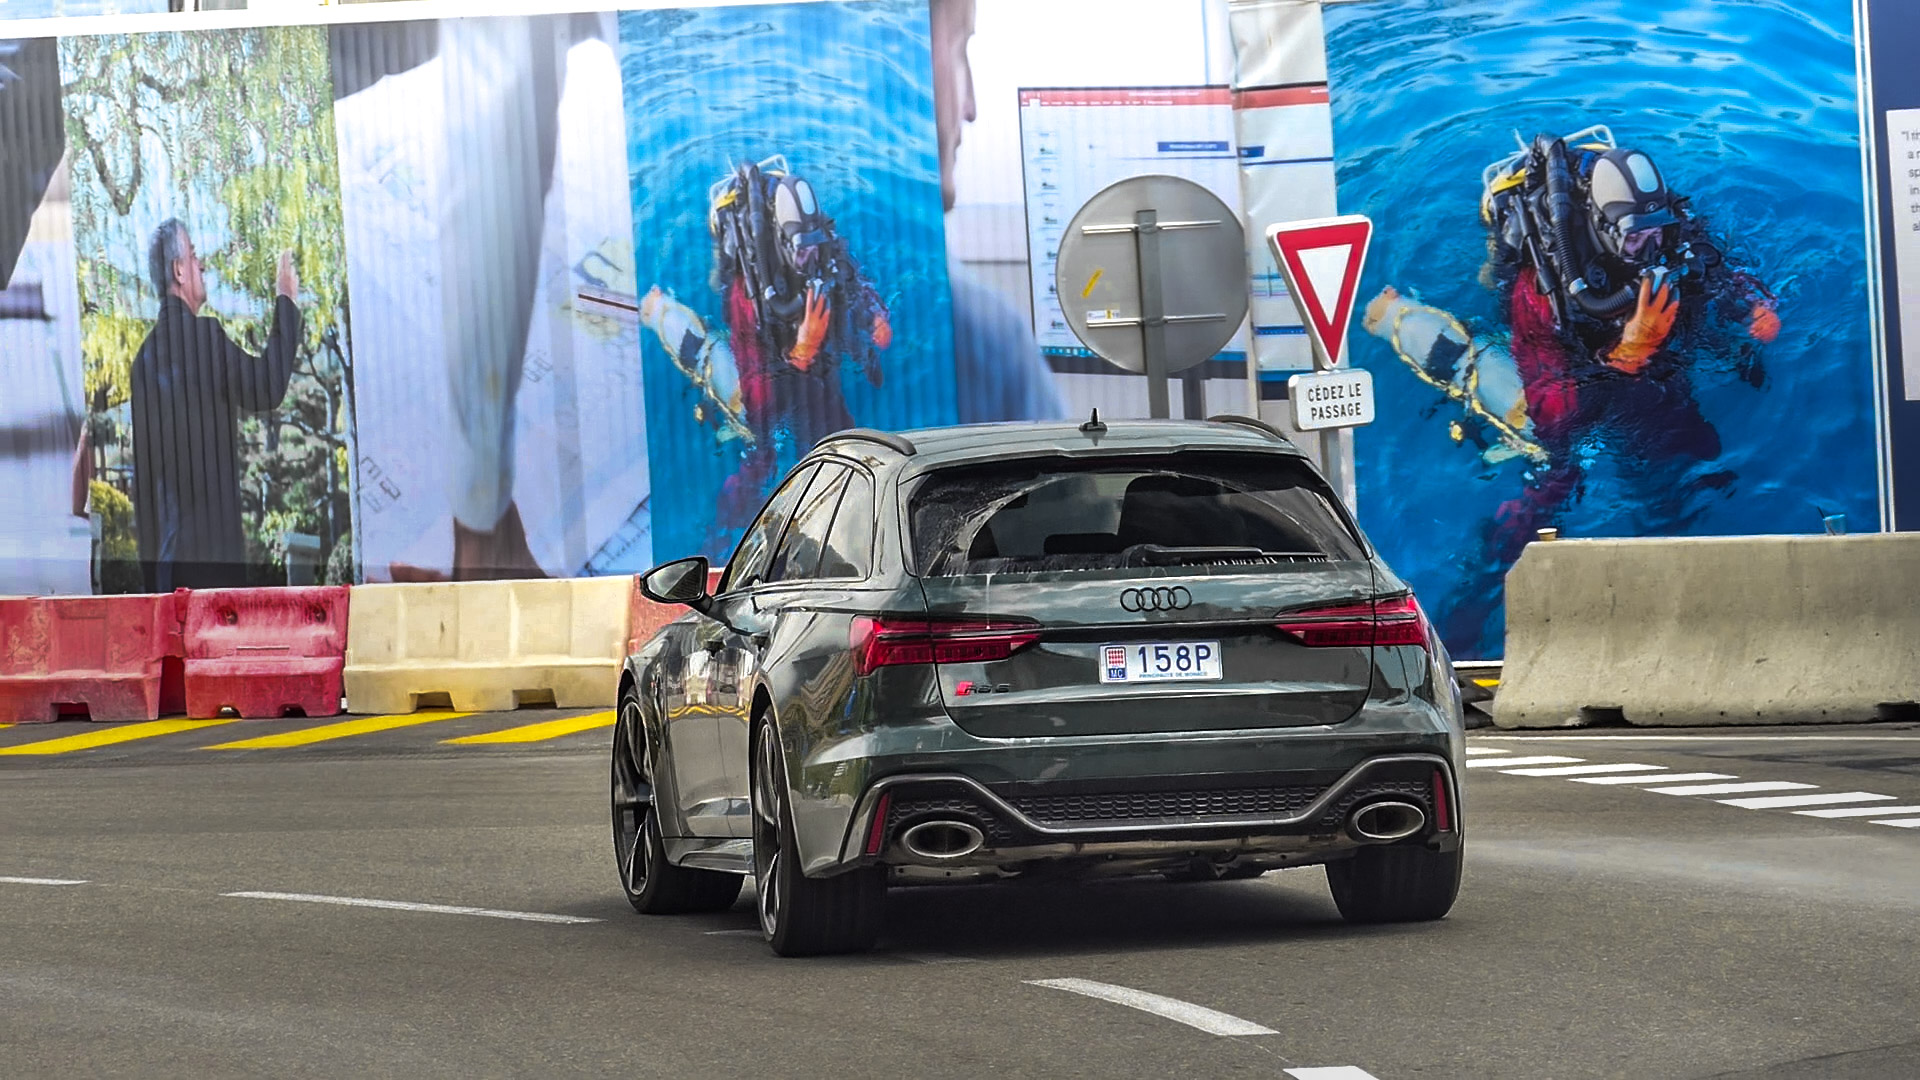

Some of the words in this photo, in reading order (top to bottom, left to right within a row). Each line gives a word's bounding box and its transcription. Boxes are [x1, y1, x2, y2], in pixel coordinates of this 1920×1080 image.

[1308, 385, 1344, 402] CÉDEZ
[1349, 383, 1362, 397] LE
[1311, 402, 1362, 420] PASSAGE
[1138, 644, 1211, 672] 158P
[1110, 669, 1125, 678] MC
